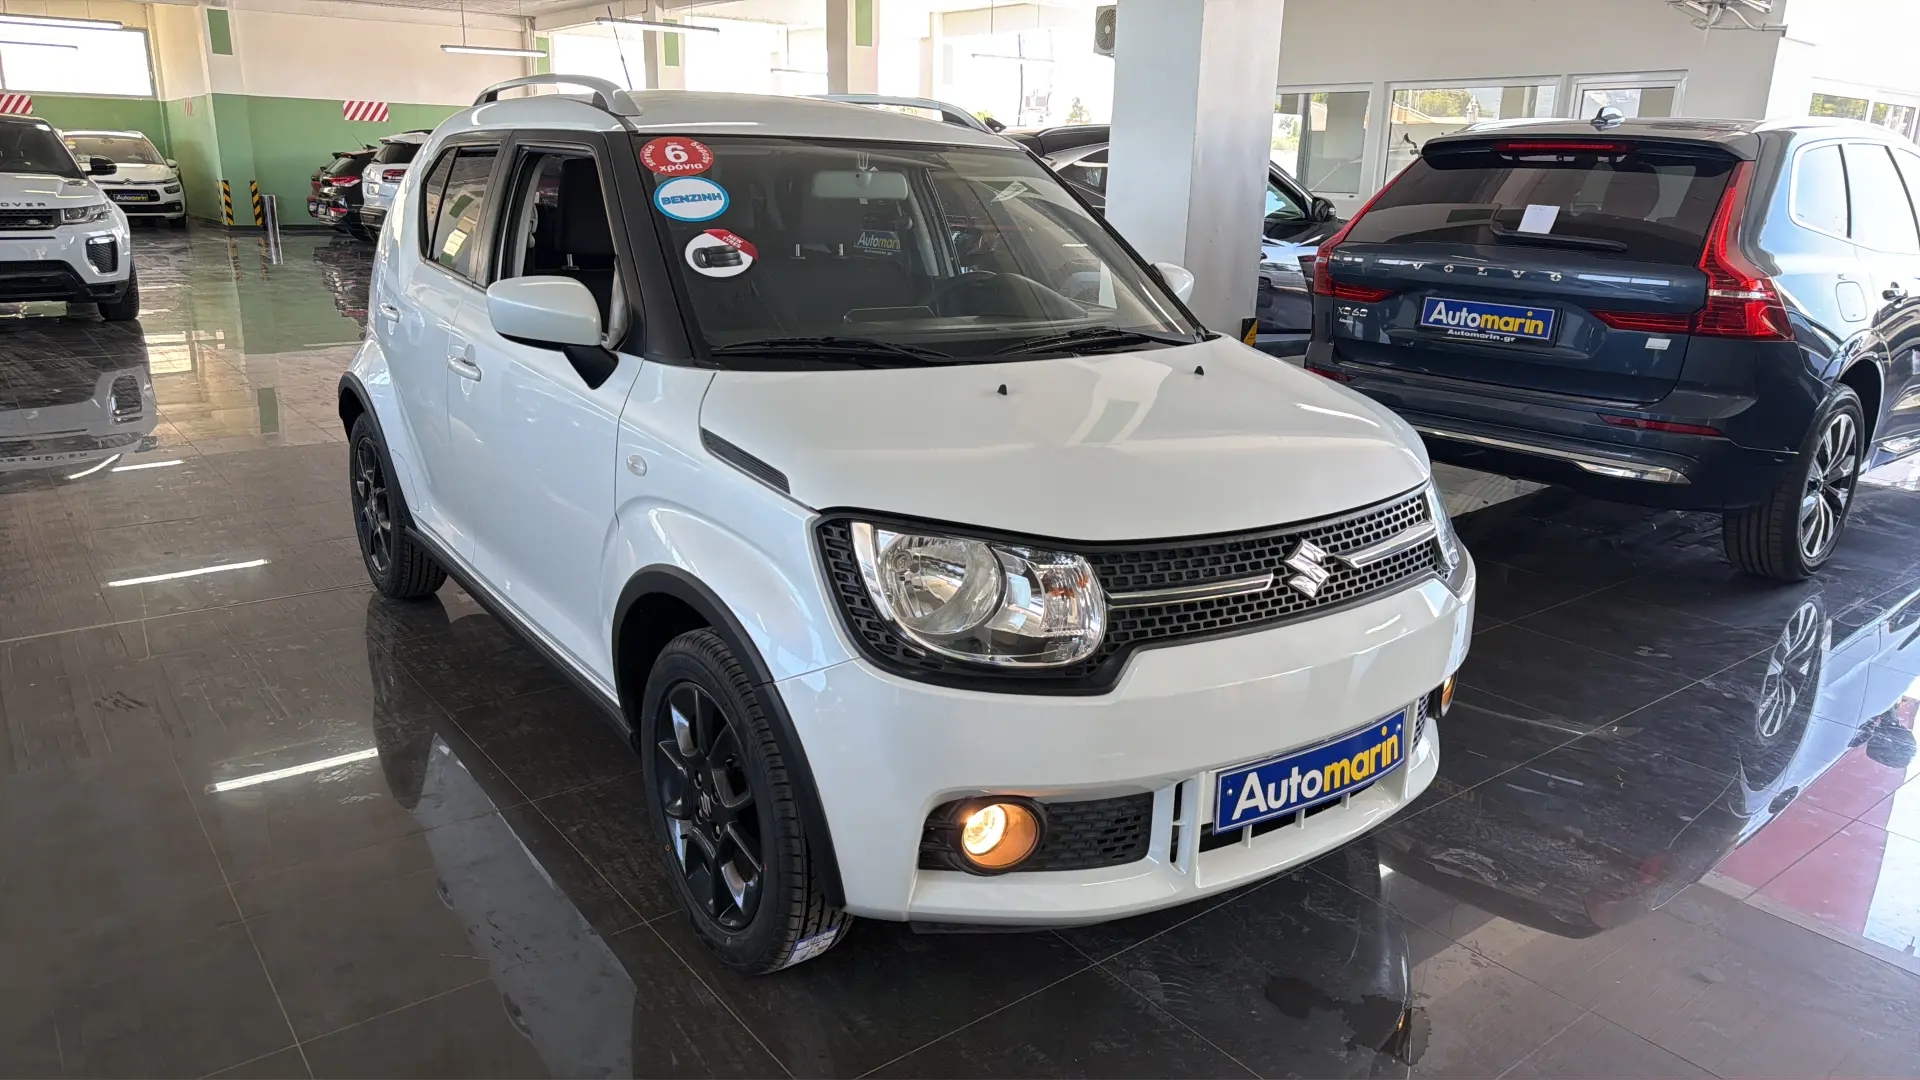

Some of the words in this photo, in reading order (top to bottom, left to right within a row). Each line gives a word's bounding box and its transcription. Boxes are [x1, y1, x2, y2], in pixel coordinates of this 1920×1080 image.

[664, 144, 689, 163] 6
[659, 162, 703, 172] χρόνια
[1412, 262, 1562, 282] VOLVO
[1428, 301, 1544, 335] Automarin
[1446, 328, 1516, 343] Automarin.gr
[1231, 725, 1399, 821] Automarin
